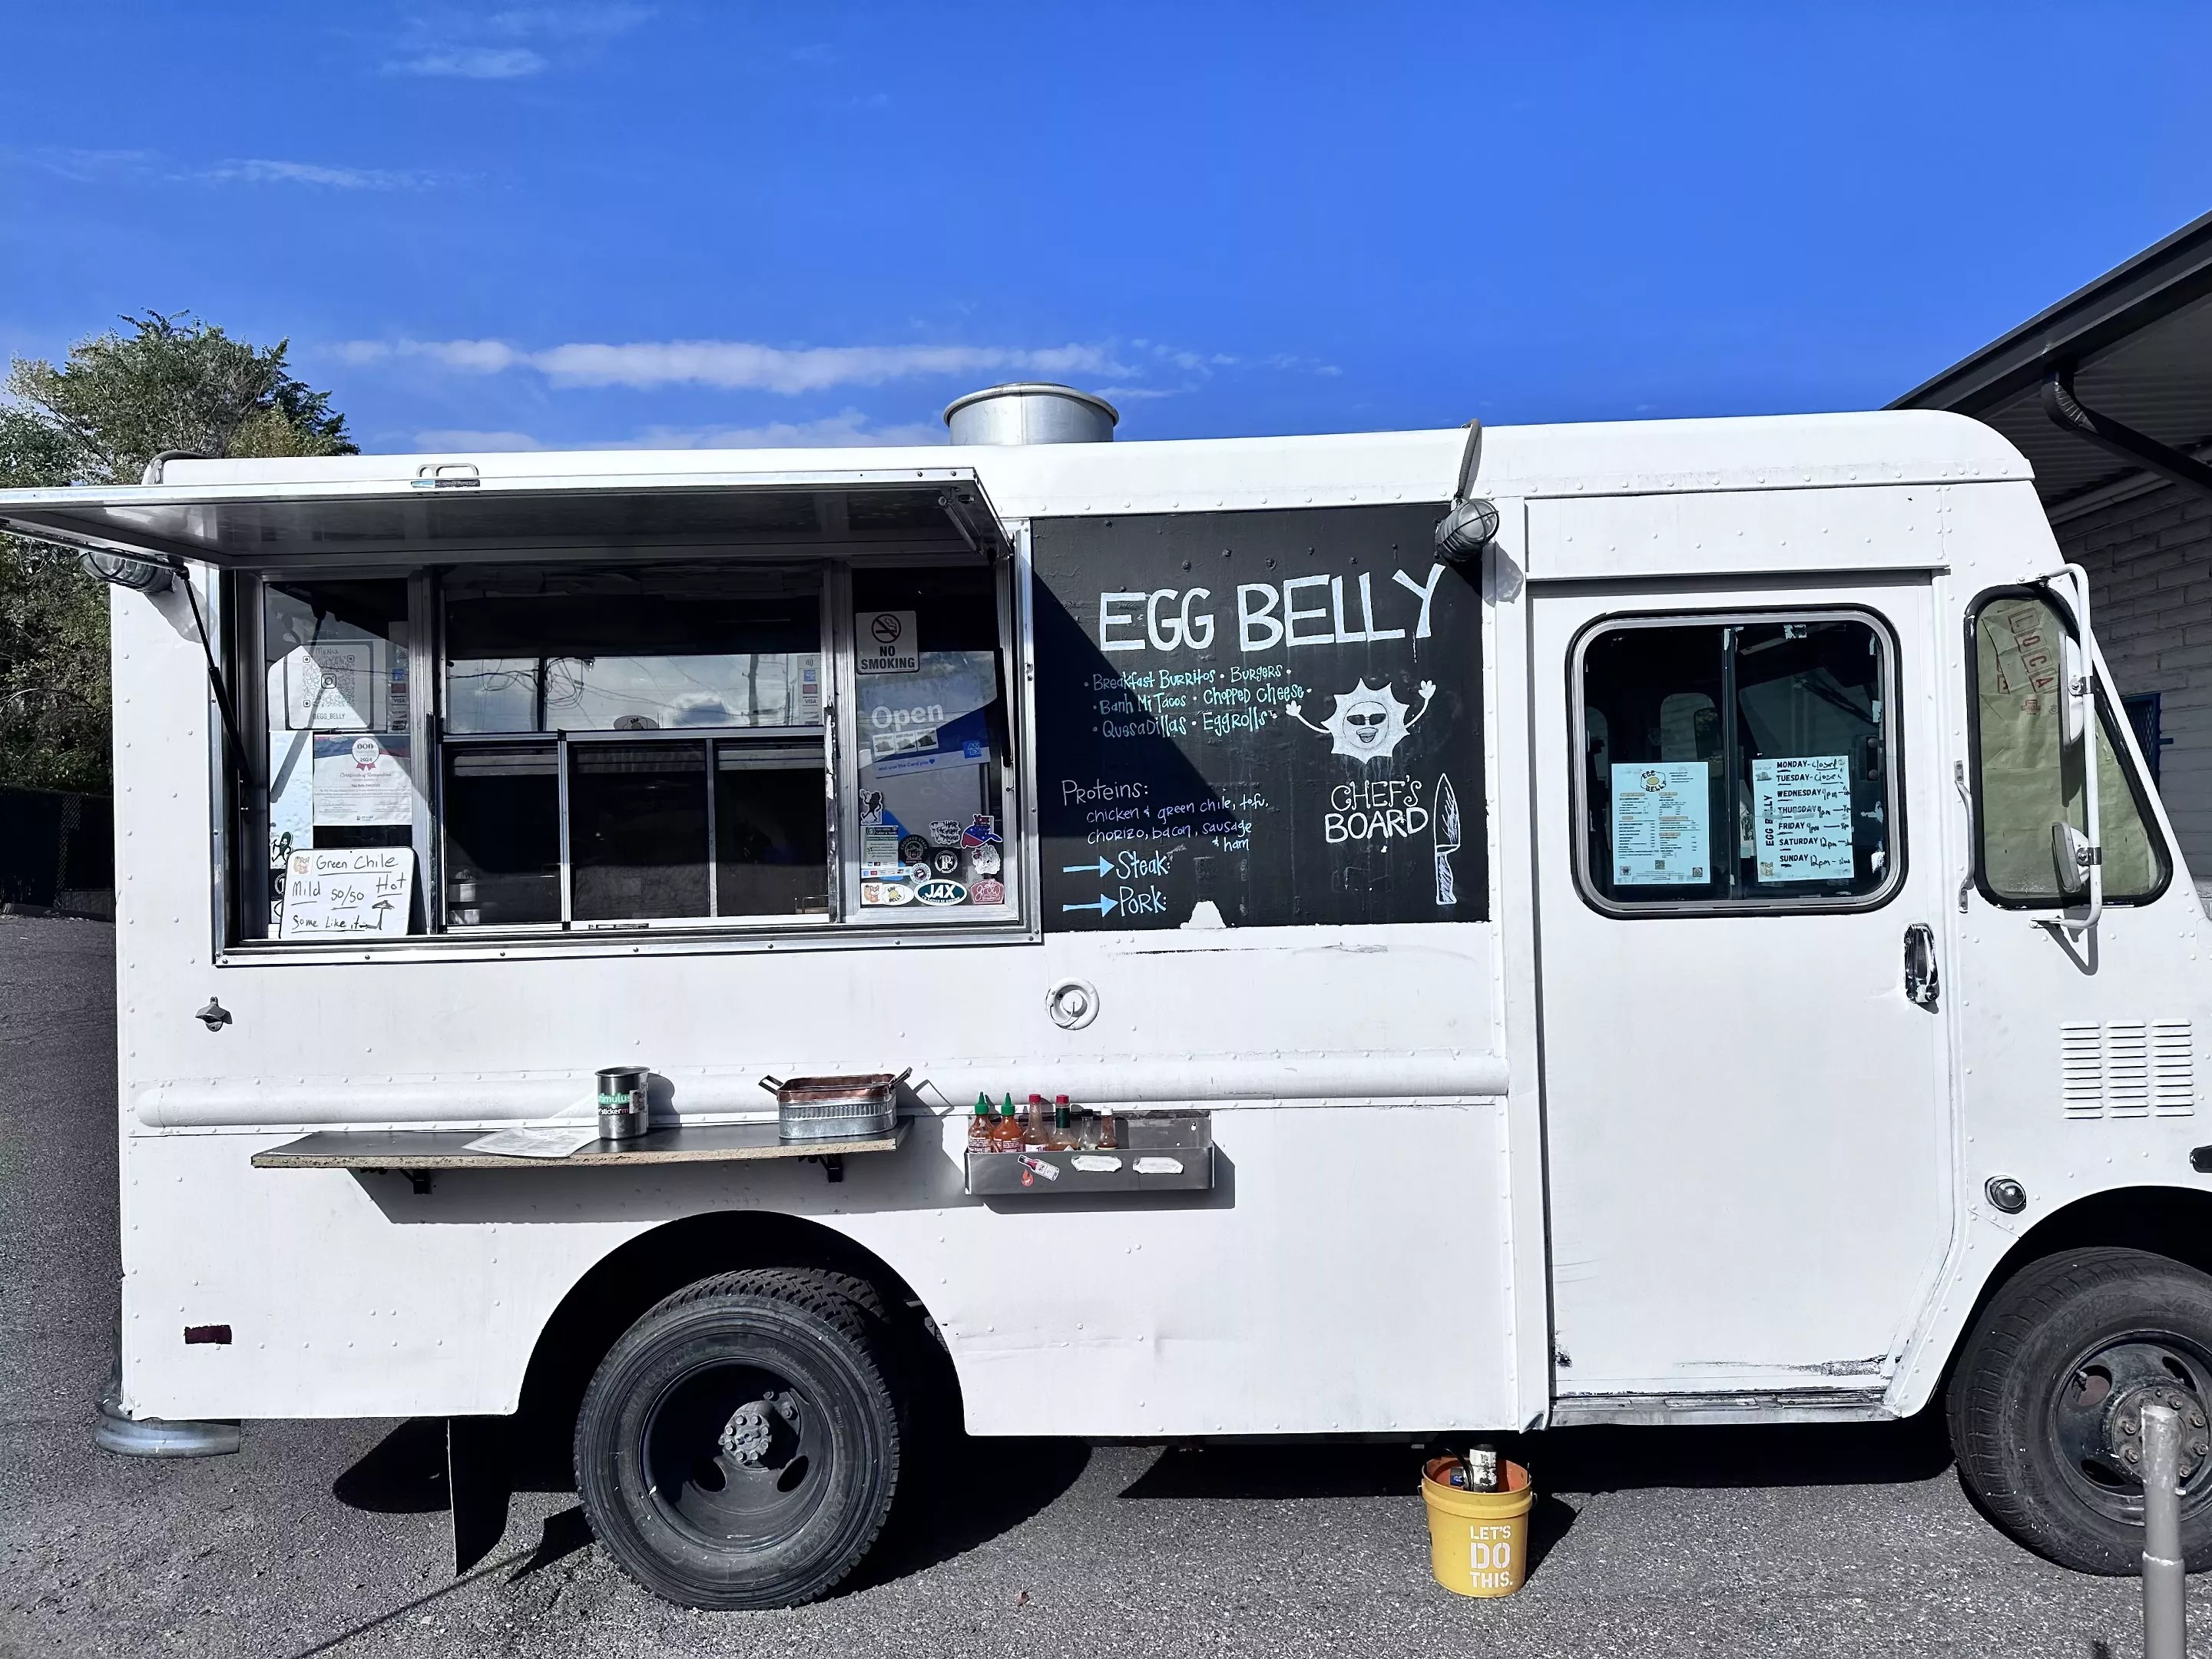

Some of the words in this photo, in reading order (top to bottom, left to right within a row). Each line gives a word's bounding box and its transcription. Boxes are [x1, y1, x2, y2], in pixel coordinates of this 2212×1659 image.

[1100, 587, 1215, 651] EGG
[1237, 563, 1445, 651] BELLY
[879, 646, 896, 657] NO
[861, 657, 916, 670] SMOKING
[1100, 694, 1134, 714] Banh
[1138, 694, 1152, 713] Mi
[1154, 693, 1187, 713] Tacos
[871, 704, 944, 731] Open
[1331, 775, 1422, 811] CHEF'S
[1645, 780, 1667, 793] BELLY
[1777, 789, 1821, 797] WEDNESDAY
[1087, 806, 1139, 823] chicken
[1157, 803, 1194, 824] green
[1200, 797, 1236, 811] chile,
[1239, 793, 1269, 810] tofu,
[1763, 795, 1773, 824] BLLY
[1088, 827, 1148, 845] chorizo,
[1202, 820, 1253, 837] sausage
[1325, 807, 1429, 843] BOARD
[1224, 836, 1250, 852] ham
[1765, 828, 1774, 846] EGG
[1780, 837, 1818, 846] SATURDAY
[316, 855, 347, 869] Green
[354, 853, 399, 869] Chile
[1116, 850, 1171, 879] Steak:
[293, 881, 320, 896] Mild
[376, 872, 406, 893] Hot
[925, 884, 955, 899] JAX
[1119, 885, 1167, 916] Pork:
[292, 915, 319, 929] Some
[325, 916, 346, 928] Like
[1470, 1525, 1512, 1540] LET'S
[1470, 1542, 1511, 1569] DO
[1470, 1571, 1513, 1588] THIS.
